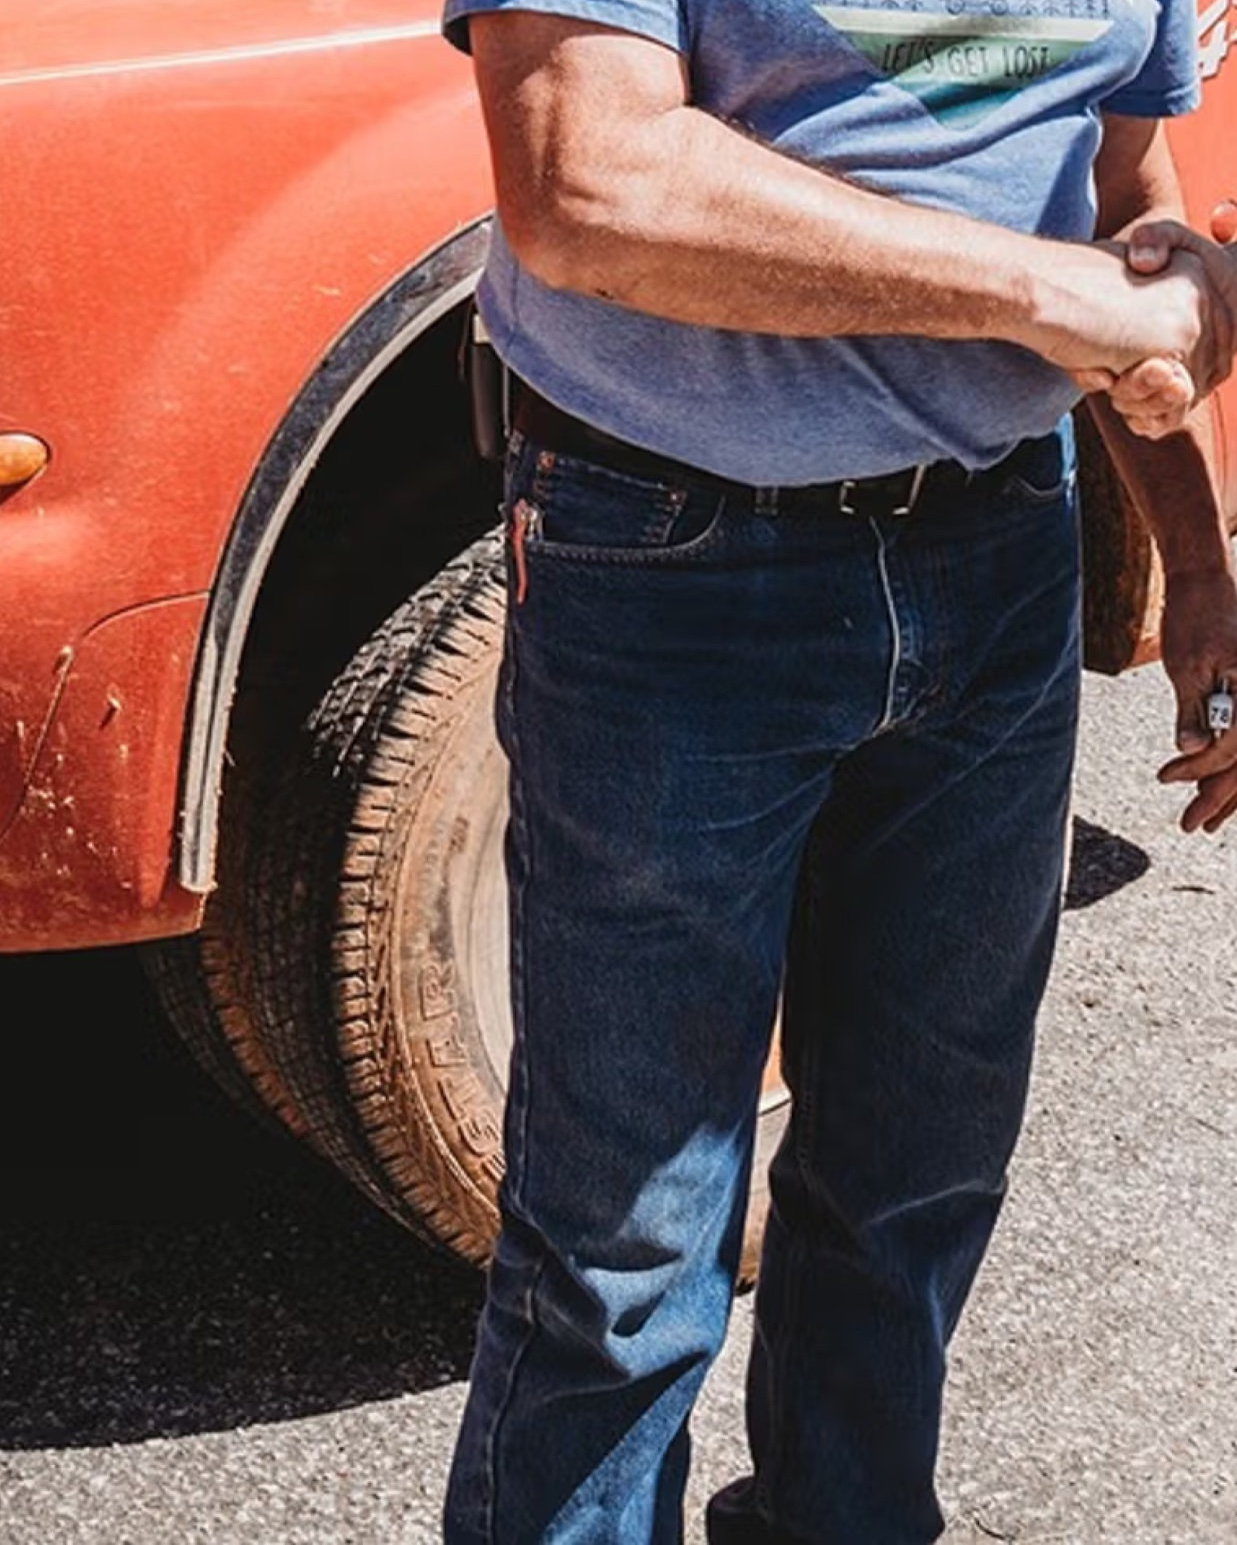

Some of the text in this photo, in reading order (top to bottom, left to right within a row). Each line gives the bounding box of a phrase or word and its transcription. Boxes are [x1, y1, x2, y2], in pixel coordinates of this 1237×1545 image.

[881, 41, 1050, 79] LET'S GET LOST
